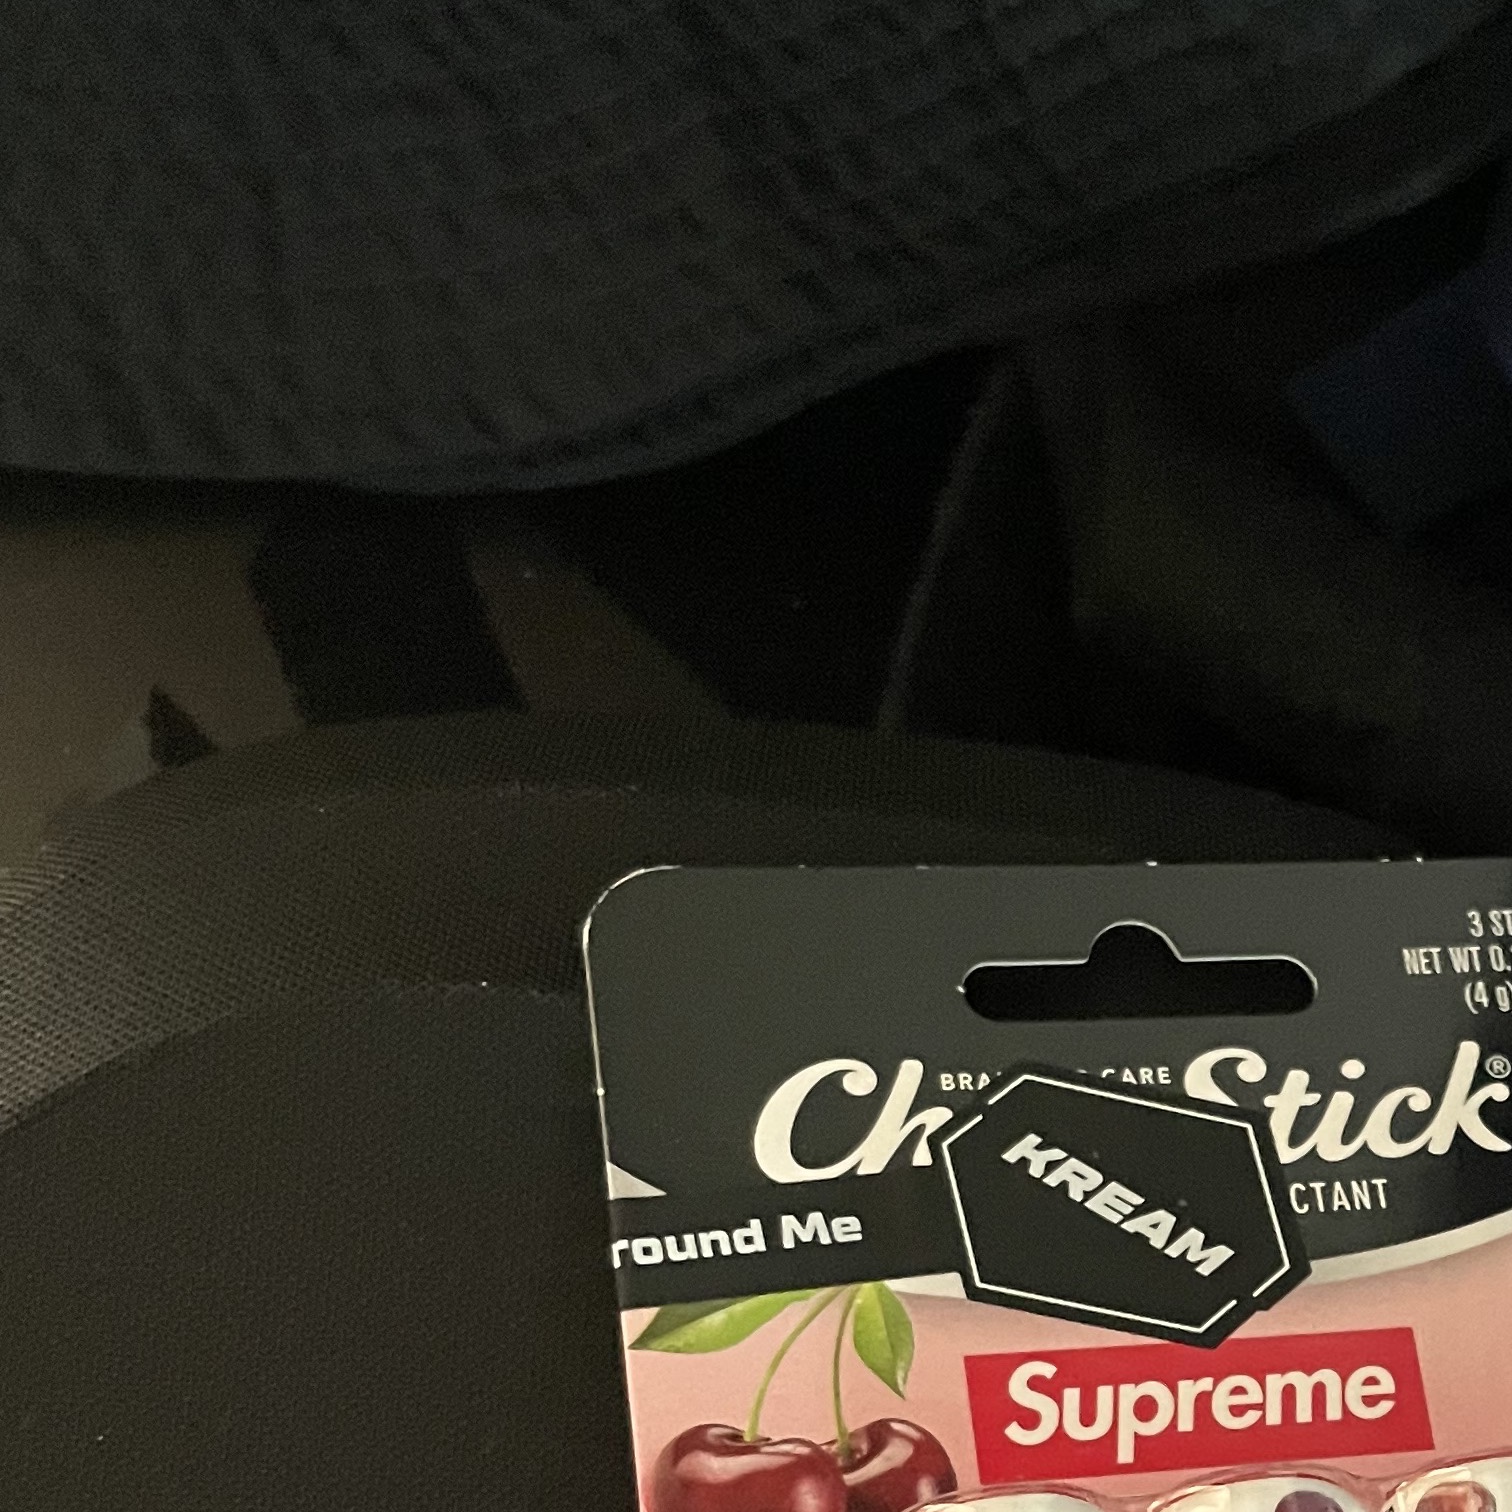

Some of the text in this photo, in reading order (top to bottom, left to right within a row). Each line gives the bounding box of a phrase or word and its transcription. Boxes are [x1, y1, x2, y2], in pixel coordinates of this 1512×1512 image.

[1467, 910, 1484, 937] 3
[1402, 947, 1442, 975] NET
[1448, 946, 1481, 973] WT
[1464, 980, 1490, 1014] (4
[941, 1071, 1001, 1092] BRA
[1001, 1133, 1235, 1277] KREAM
[1289, 1179, 1388, 1214] CTANT
[611, 1211, 863, 1269] round Me
[1004, 1360, 1396, 1464] Supreme
